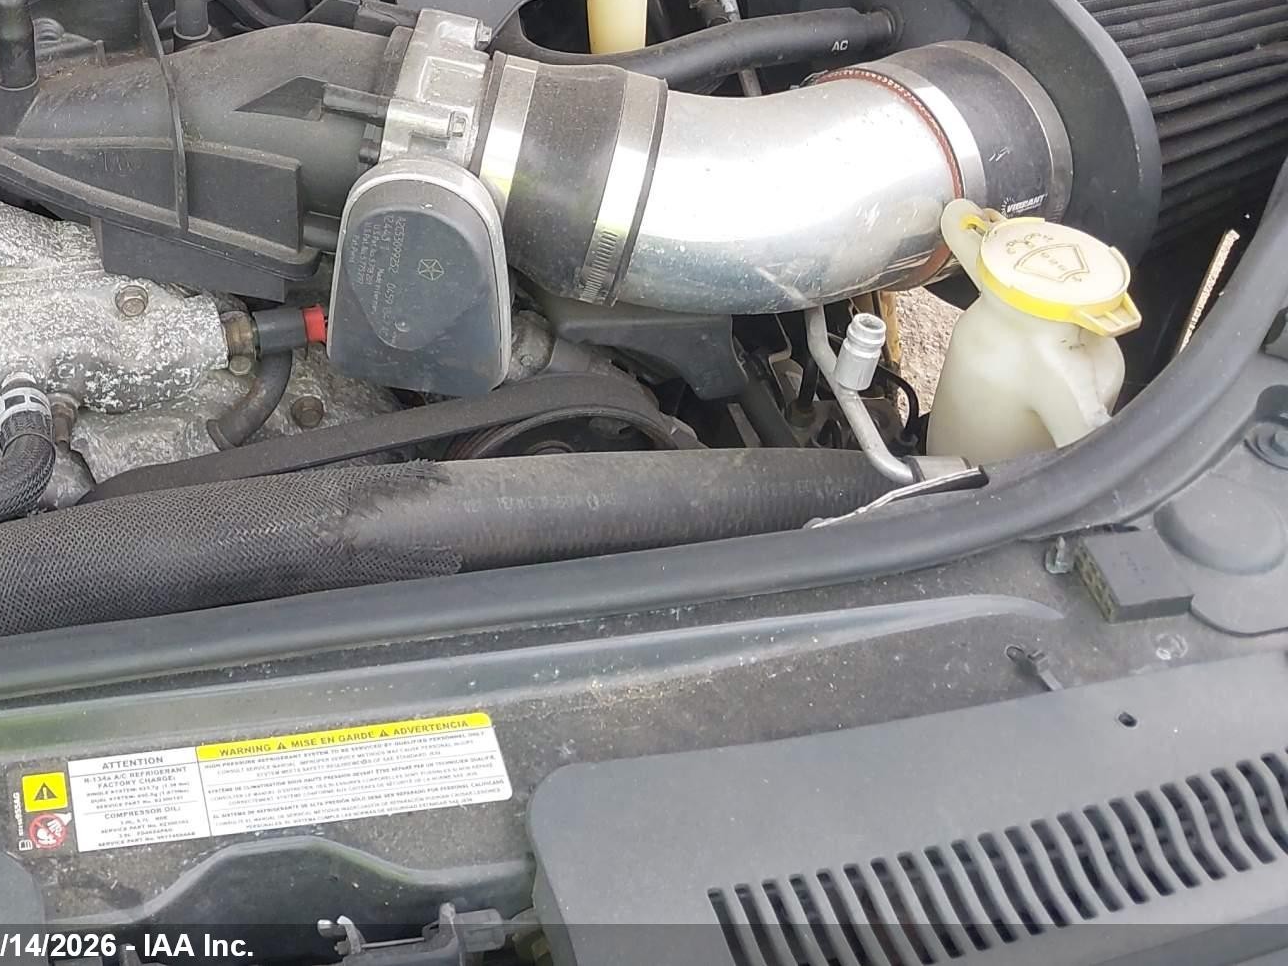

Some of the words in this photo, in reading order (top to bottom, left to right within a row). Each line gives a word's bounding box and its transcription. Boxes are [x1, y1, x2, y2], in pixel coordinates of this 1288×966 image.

[831, 39, 849, 52] AC
[1007, 194, 1045, 213] VIBRANT
[218, 742, 272, 757] WARNING
[290, 737, 317, 748] MISE
[319, 735, 335, 745] EN
[337, 730, 375, 743] GARDE
[392, 719, 469, 736] ADVERTENCIA
[100, 755, 164, 770] ATTENTION
[113, 772, 127, 781] A/C
[128, 765, 187, 779] REFRIGERANT
[96, 778, 137, 789] FACTORY
[103, 806, 162, 820] COMPRESSOR
